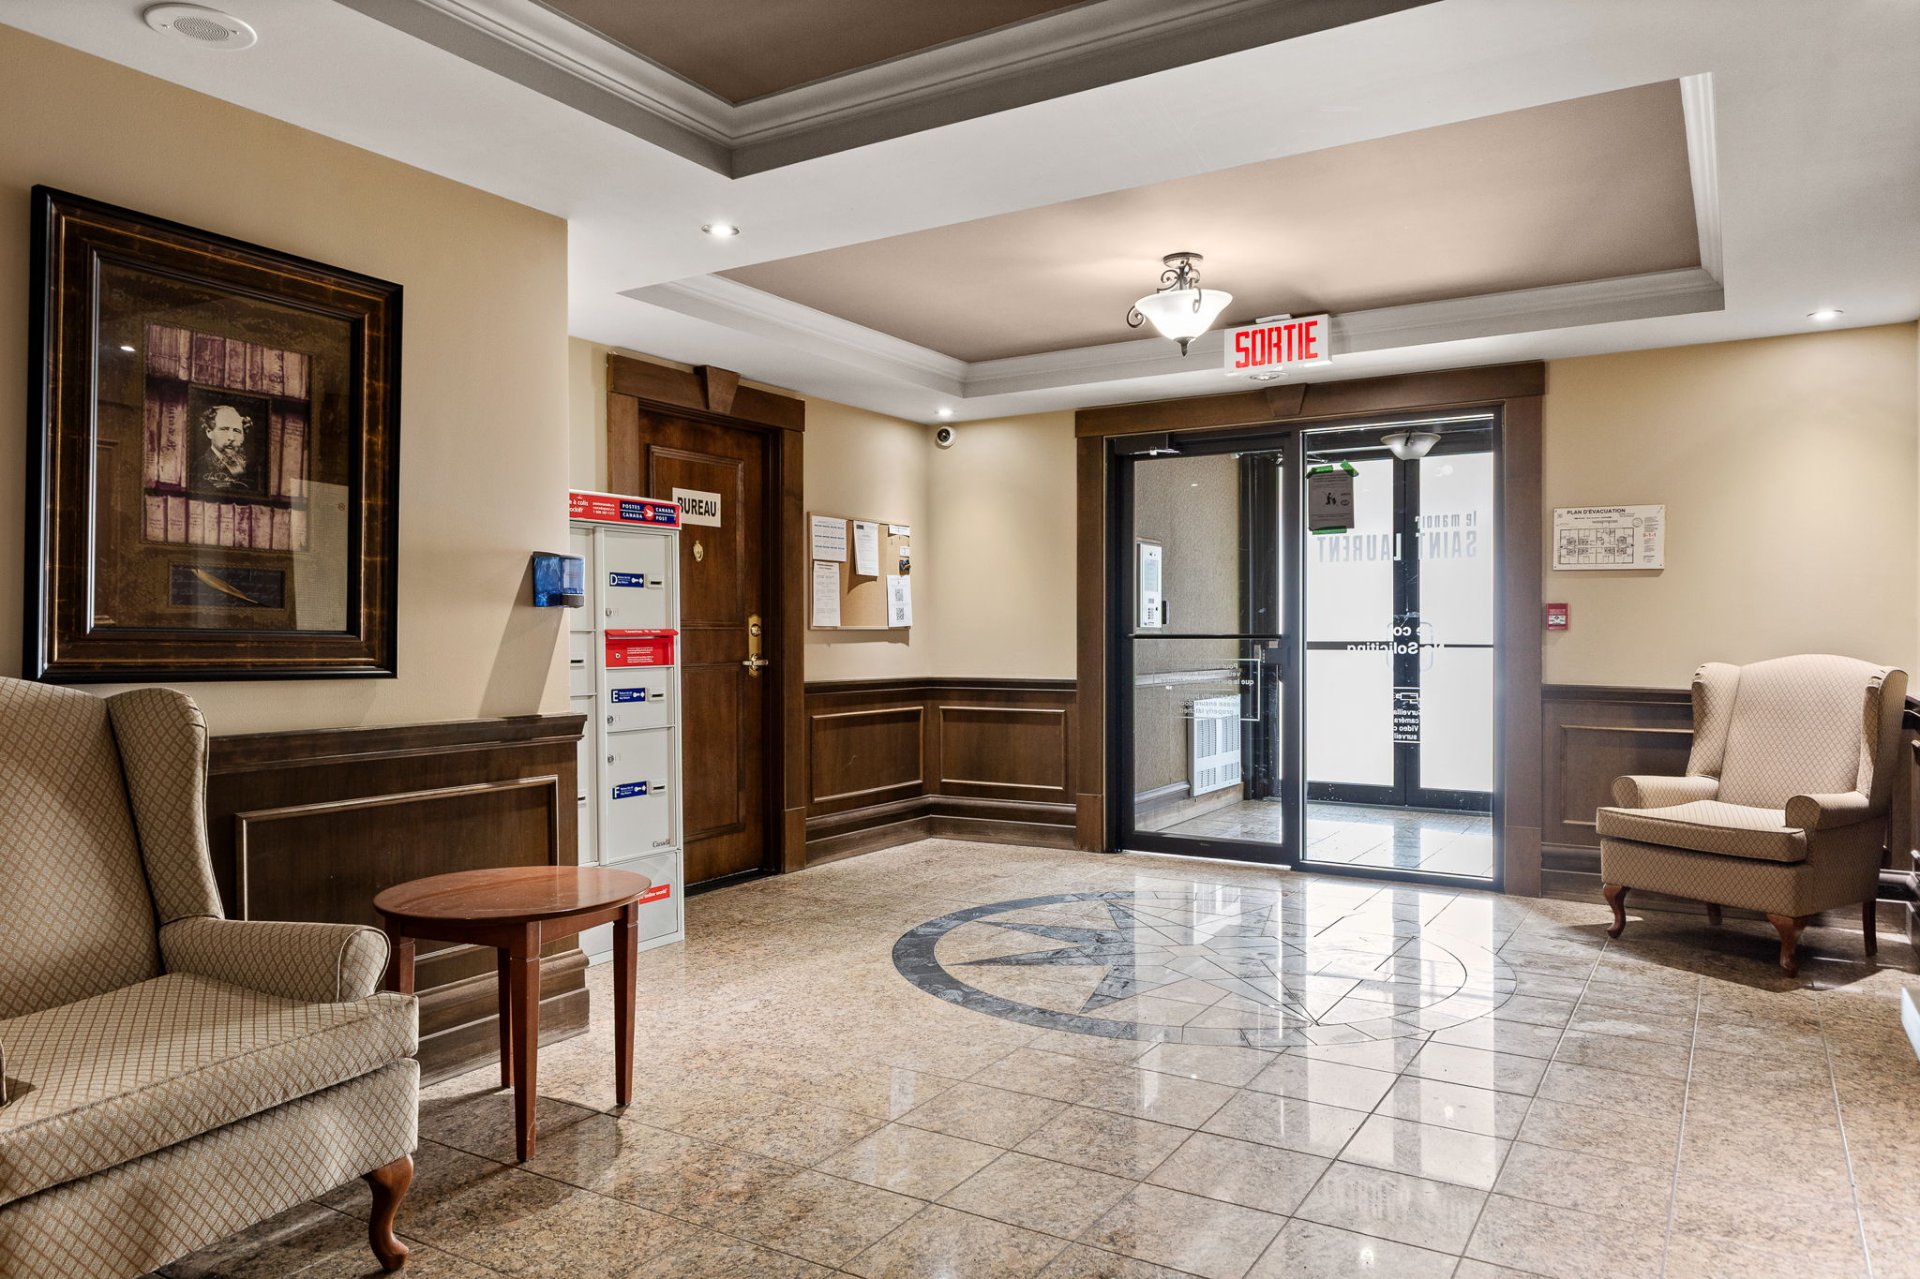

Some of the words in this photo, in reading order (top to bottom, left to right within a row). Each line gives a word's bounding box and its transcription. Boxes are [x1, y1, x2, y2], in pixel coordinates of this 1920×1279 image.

[1235, 320, 1318, 368] SORTIE
[677, 497, 717, 517] BUREAU
[610, 574, 618, 585] D
[612, 690, 619, 702] E
[614, 787, 620, 798] F
